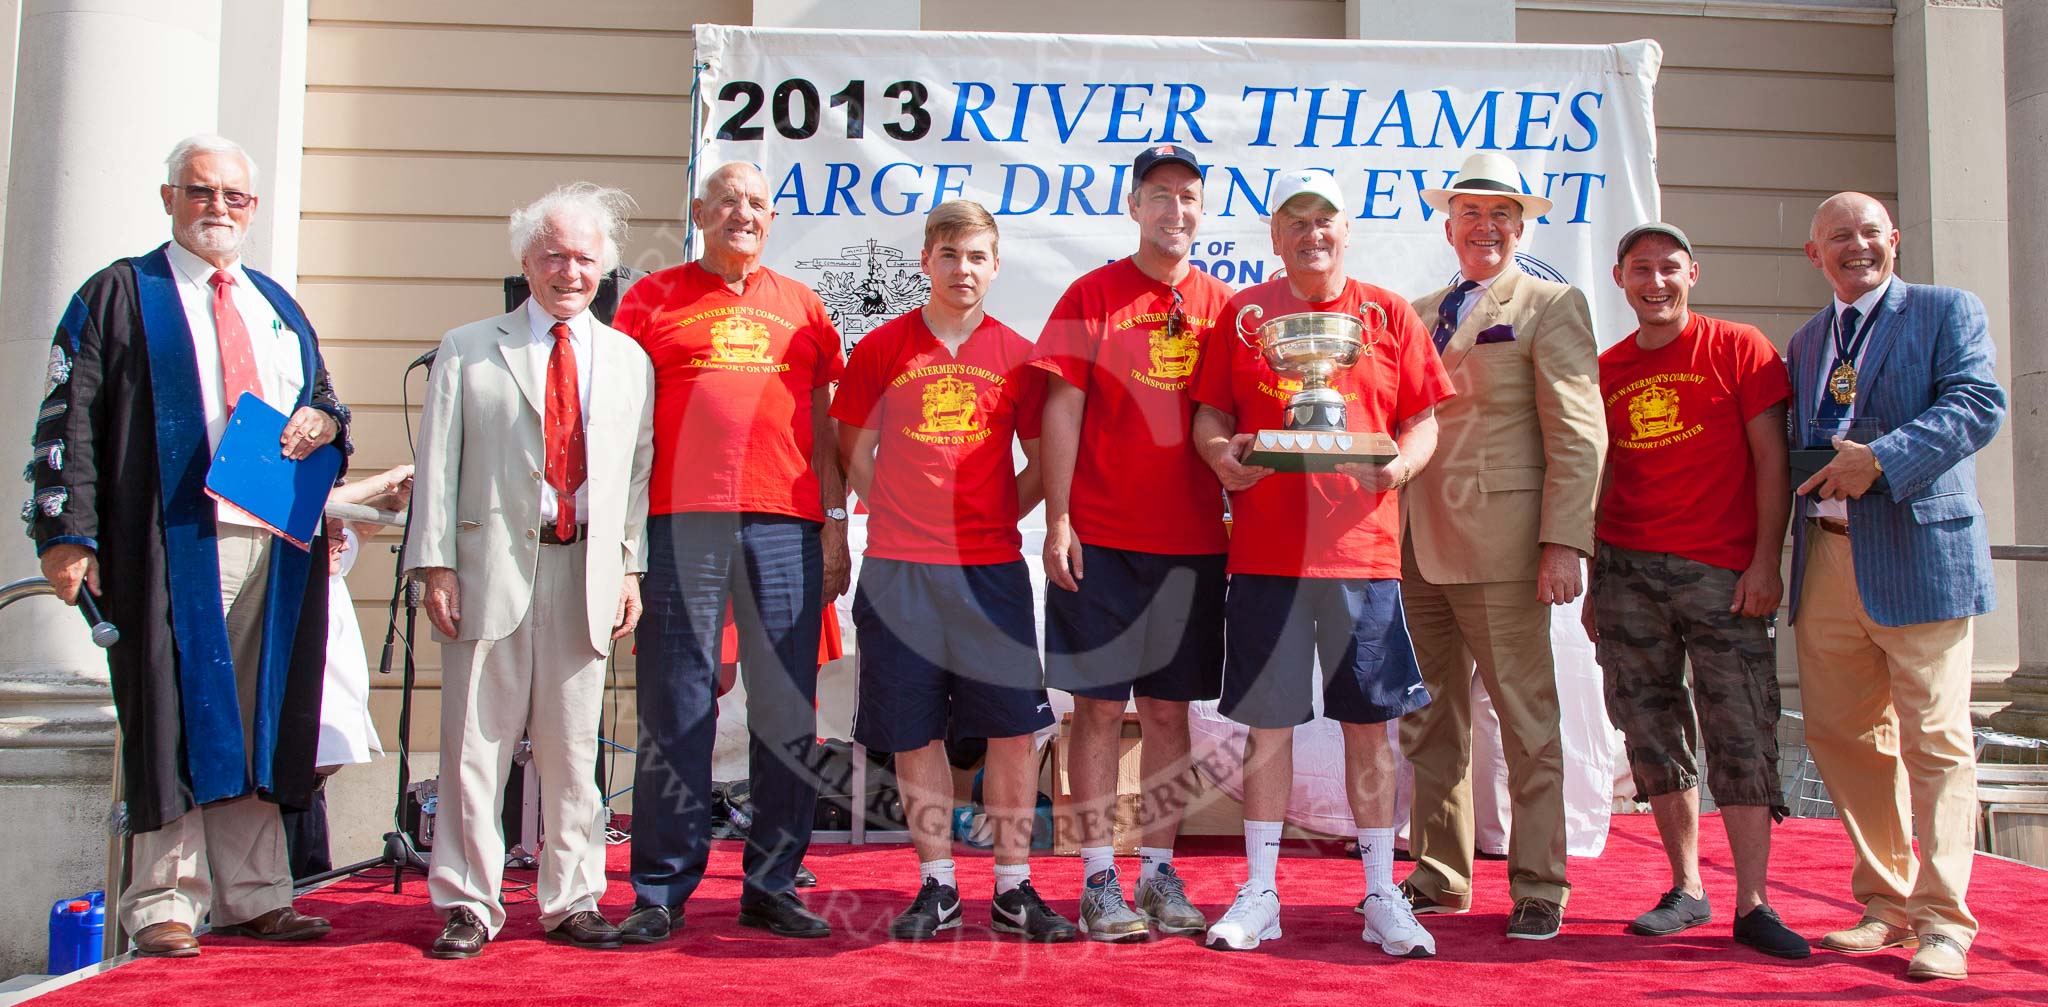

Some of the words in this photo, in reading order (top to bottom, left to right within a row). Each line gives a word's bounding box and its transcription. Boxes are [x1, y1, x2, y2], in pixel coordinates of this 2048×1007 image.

[716, 78, 932, 142] 2013
[942, 81, 1212, 144] RIVER
[1243, 86, 1605, 153] THAMES
[753, 162, 972, 217] ARGE
[1356, 168, 1606, 226] EVNT
[1207, 241, 1236, 256] OF
[694, 306, 755, 321] WATERMEN'S
[755, 309, 797, 331] COMPANY
[1115, 318, 1136, 331] THE
[746, 365, 761, 373] ON
[761, 363, 791, 374] WATER
[891, 373, 910, 389] THE
[907, 363, 966, 379] WATERMEN'S
[965, 365, 1008, 387] COMPANY
[1130, 368, 1177, 391] TRANSPORT
[1257, 381, 1291, 401] TRANSP
[1606, 394, 1620, 408] THE
[1617, 374, 1670, 397] WATERMEN'S
[902, 425, 951, 445] TRANSPORT
[951, 435, 965, 445] ON
[965, 427, 993, 443] WATER
[1660, 436, 1672, 447] ON
[1672, 423, 1705, 443] WATER
